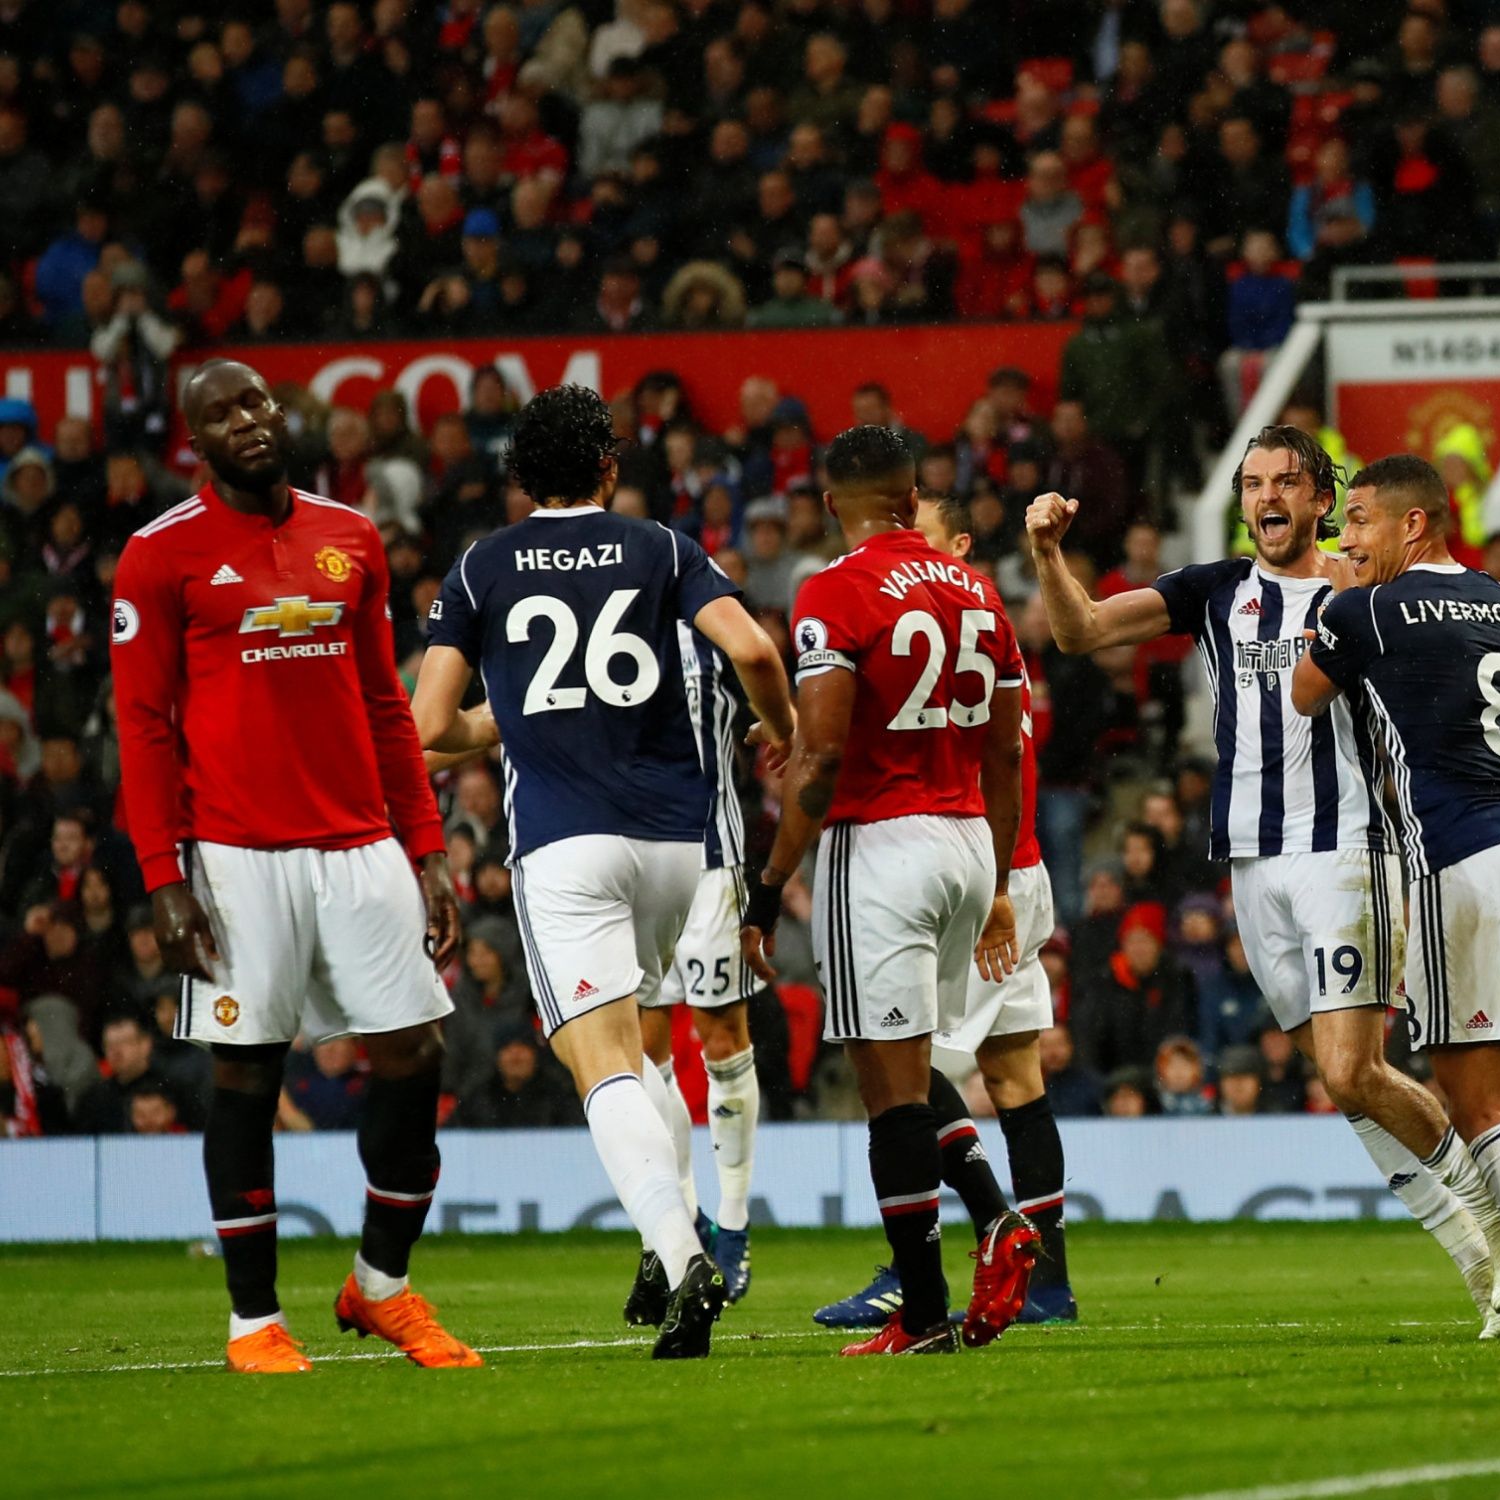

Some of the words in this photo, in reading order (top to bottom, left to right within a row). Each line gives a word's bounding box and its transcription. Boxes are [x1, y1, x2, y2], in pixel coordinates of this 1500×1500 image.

[515, 544, 623, 571] HEGAZI
[879, 561, 986, 604] VALENCIA
[241, 642, 347, 663] CHEVROLET
[506, 589, 660, 716] 26
[887, 610, 996, 730] 25
[687, 956, 730, 996] 25
[1314, 945, 1363, 996] 19
